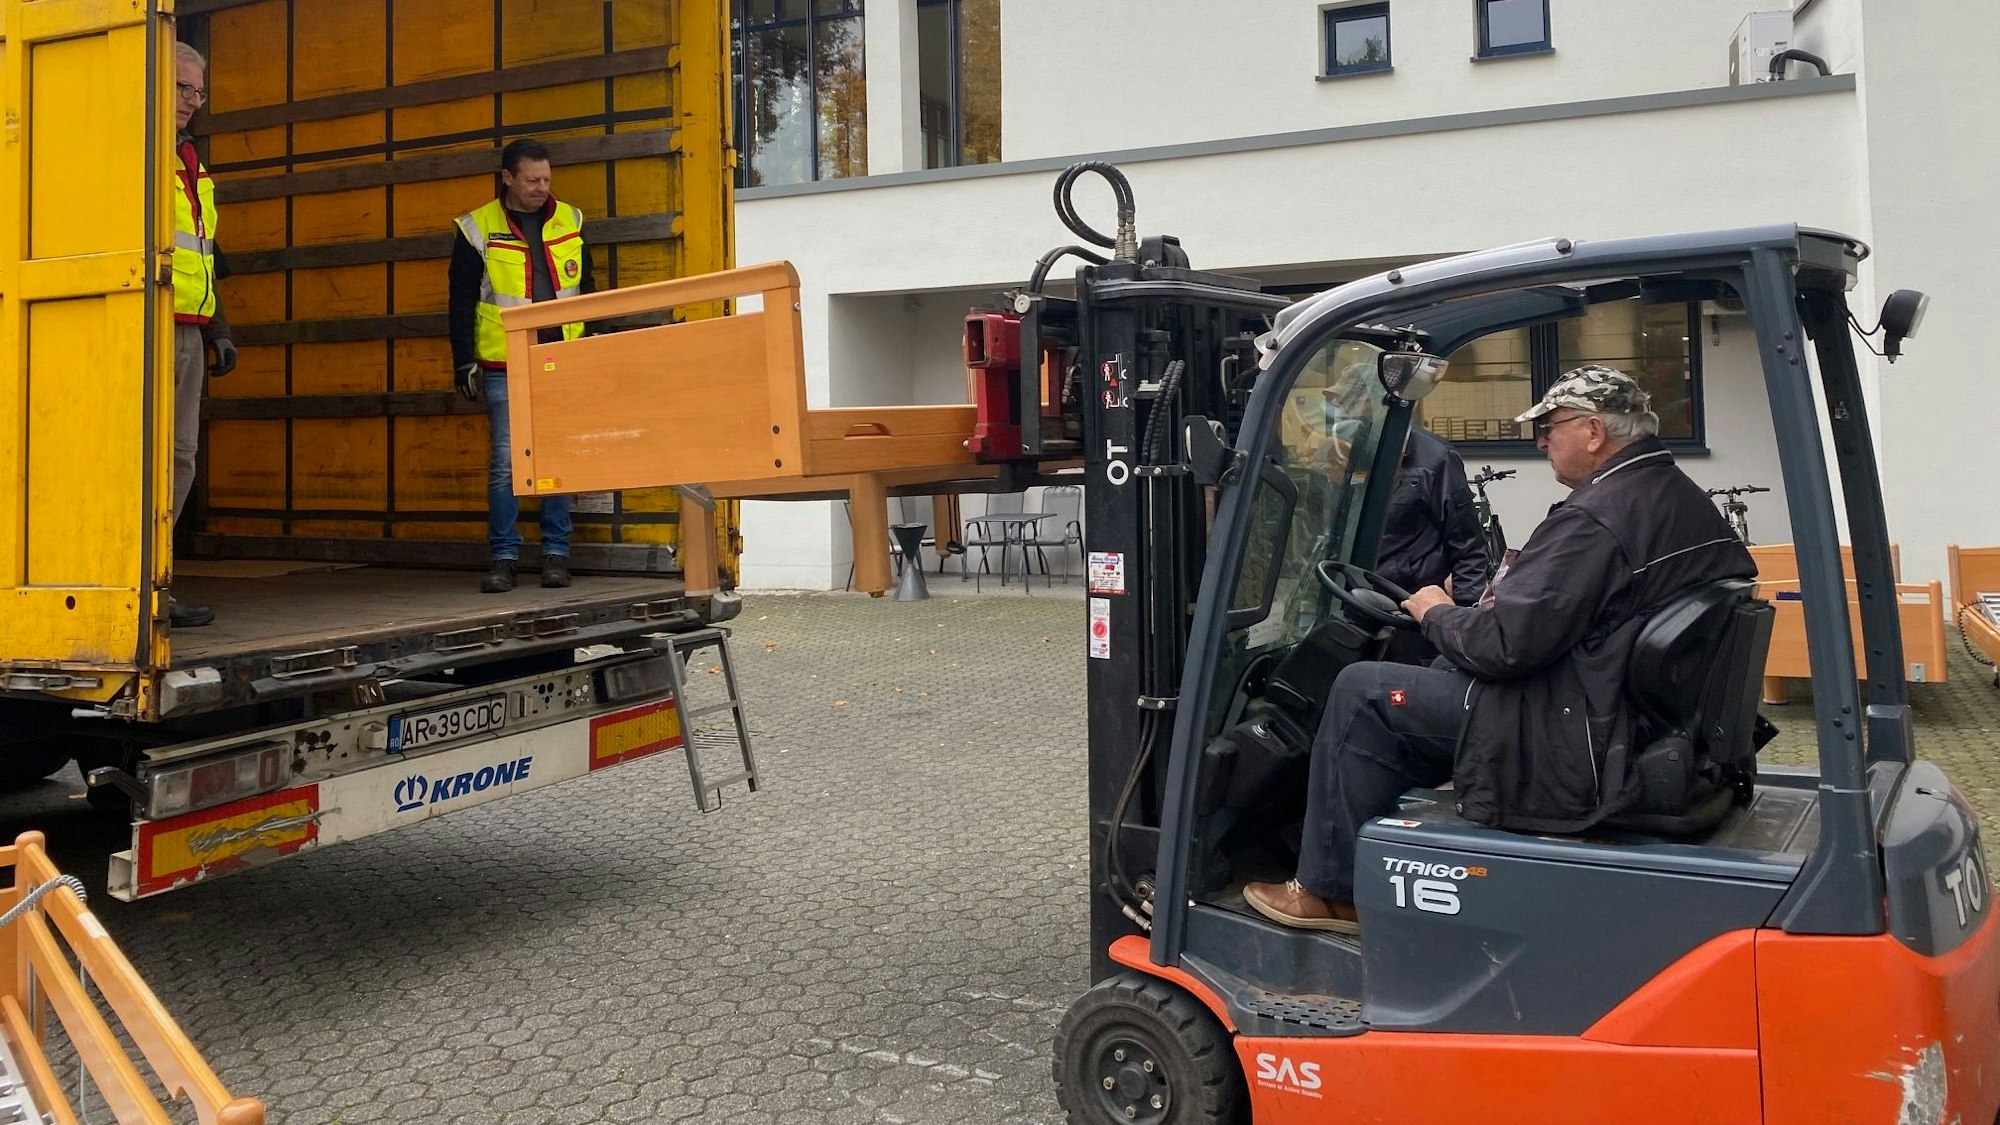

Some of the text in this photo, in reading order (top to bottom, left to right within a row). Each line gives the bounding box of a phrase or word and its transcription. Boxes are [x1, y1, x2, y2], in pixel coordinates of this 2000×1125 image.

[390, 737, 400, 748] RO
[402, 702, 503, 746] AR 39 CDC
[429, 756, 533, 804] KRONE
[1389, 875, 1461, 915] 16
[1256, 1052, 1322, 1090] SAS
